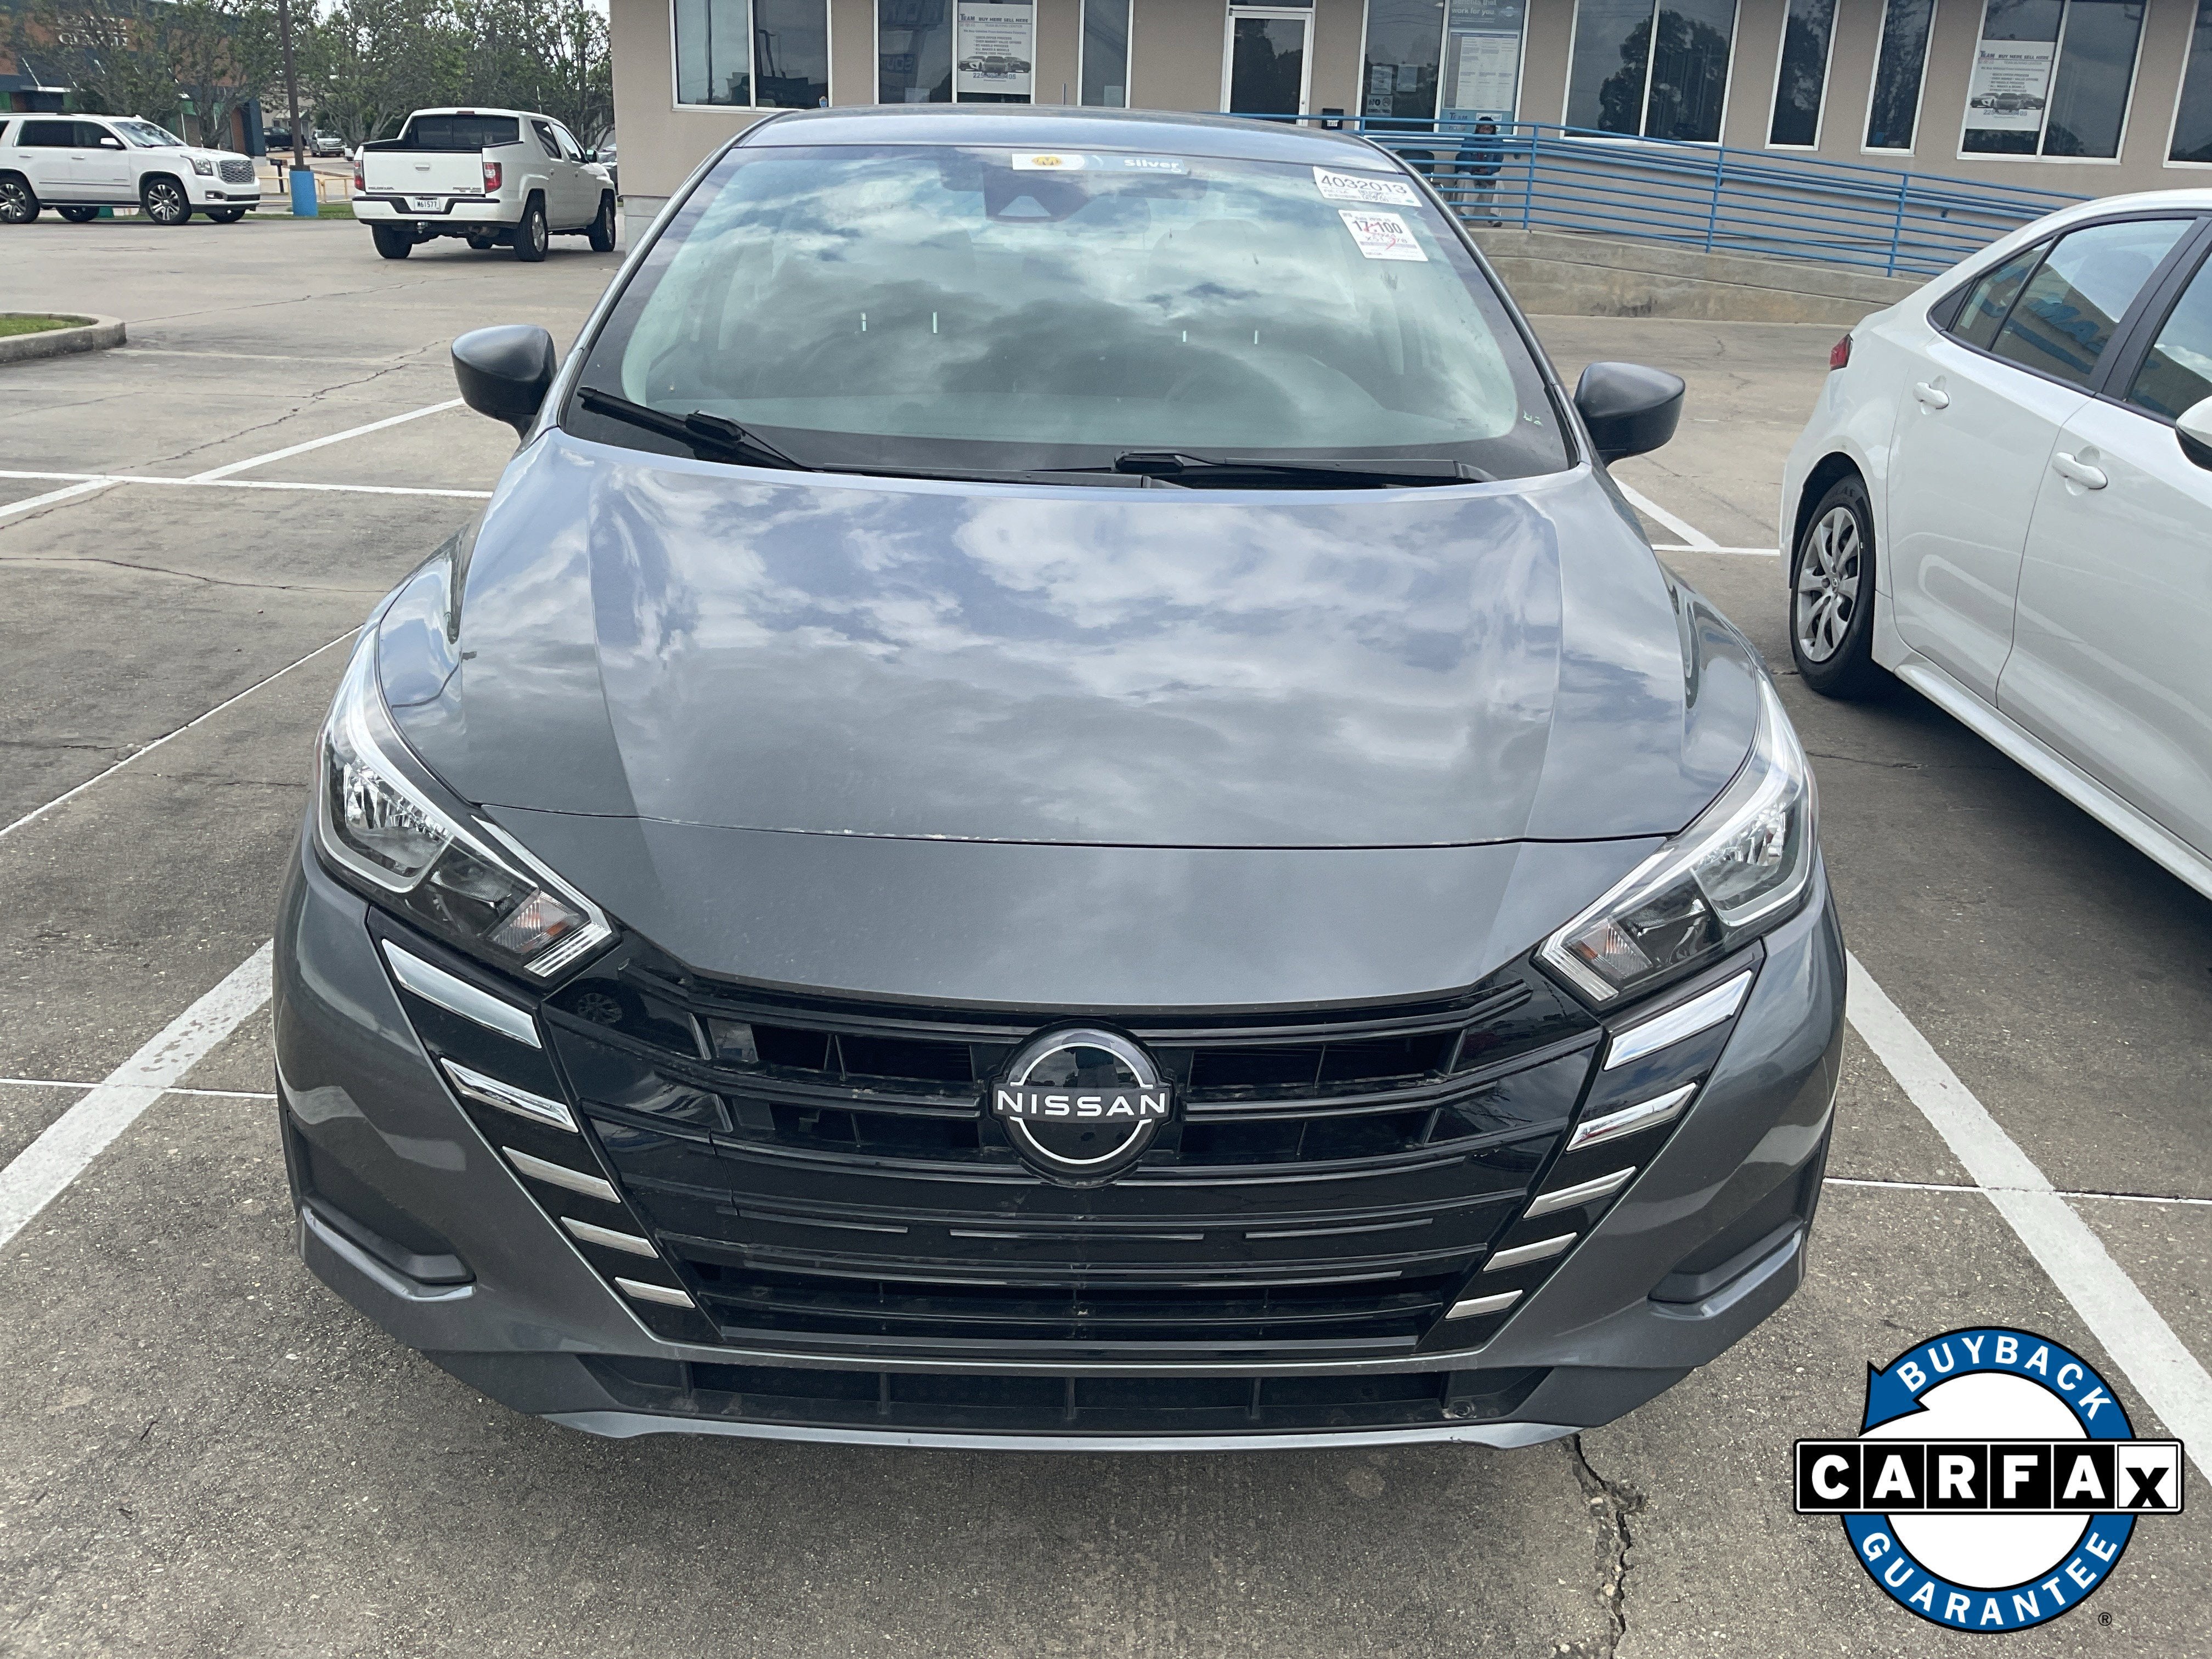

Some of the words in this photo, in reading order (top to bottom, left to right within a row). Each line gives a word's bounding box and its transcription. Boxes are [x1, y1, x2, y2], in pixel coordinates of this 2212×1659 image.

[1125, 159, 1179, 168] Silver
[1321, 175, 1407, 193] 4032013
[997, 1090, 1165, 1117] NISSAN
